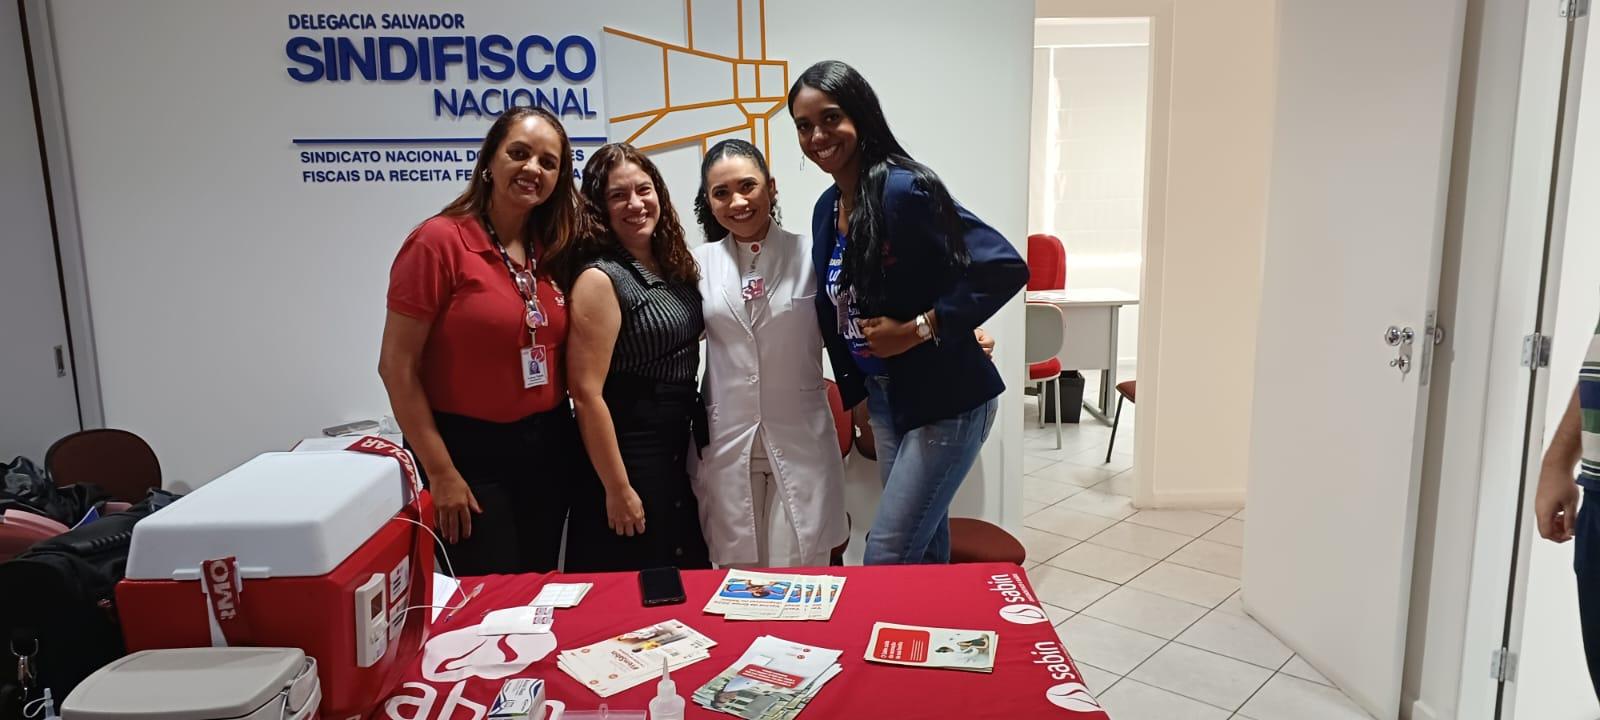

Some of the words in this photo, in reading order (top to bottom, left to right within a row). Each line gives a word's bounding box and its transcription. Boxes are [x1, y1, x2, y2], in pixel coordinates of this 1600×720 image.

[288, 14, 376, 30] DELEGACIA
[381, 13, 465, 29] SALVADOR
[286, 34, 597, 82] SINDIFISCO
[433, 87, 597, 117] NACIONAL
[300, 150, 381, 163] SINDICATO
[385, 149, 462, 163] NACIONAL
[303, 170, 360, 183] FISCAIS
[364, 169, 385, 182] DA
[390, 169, 452, 182] RECEITA
[456, 169, 473, 181] FE
[987, 573, 1025, 603] sabin
[1030, 641, 1076, 681] sabin
